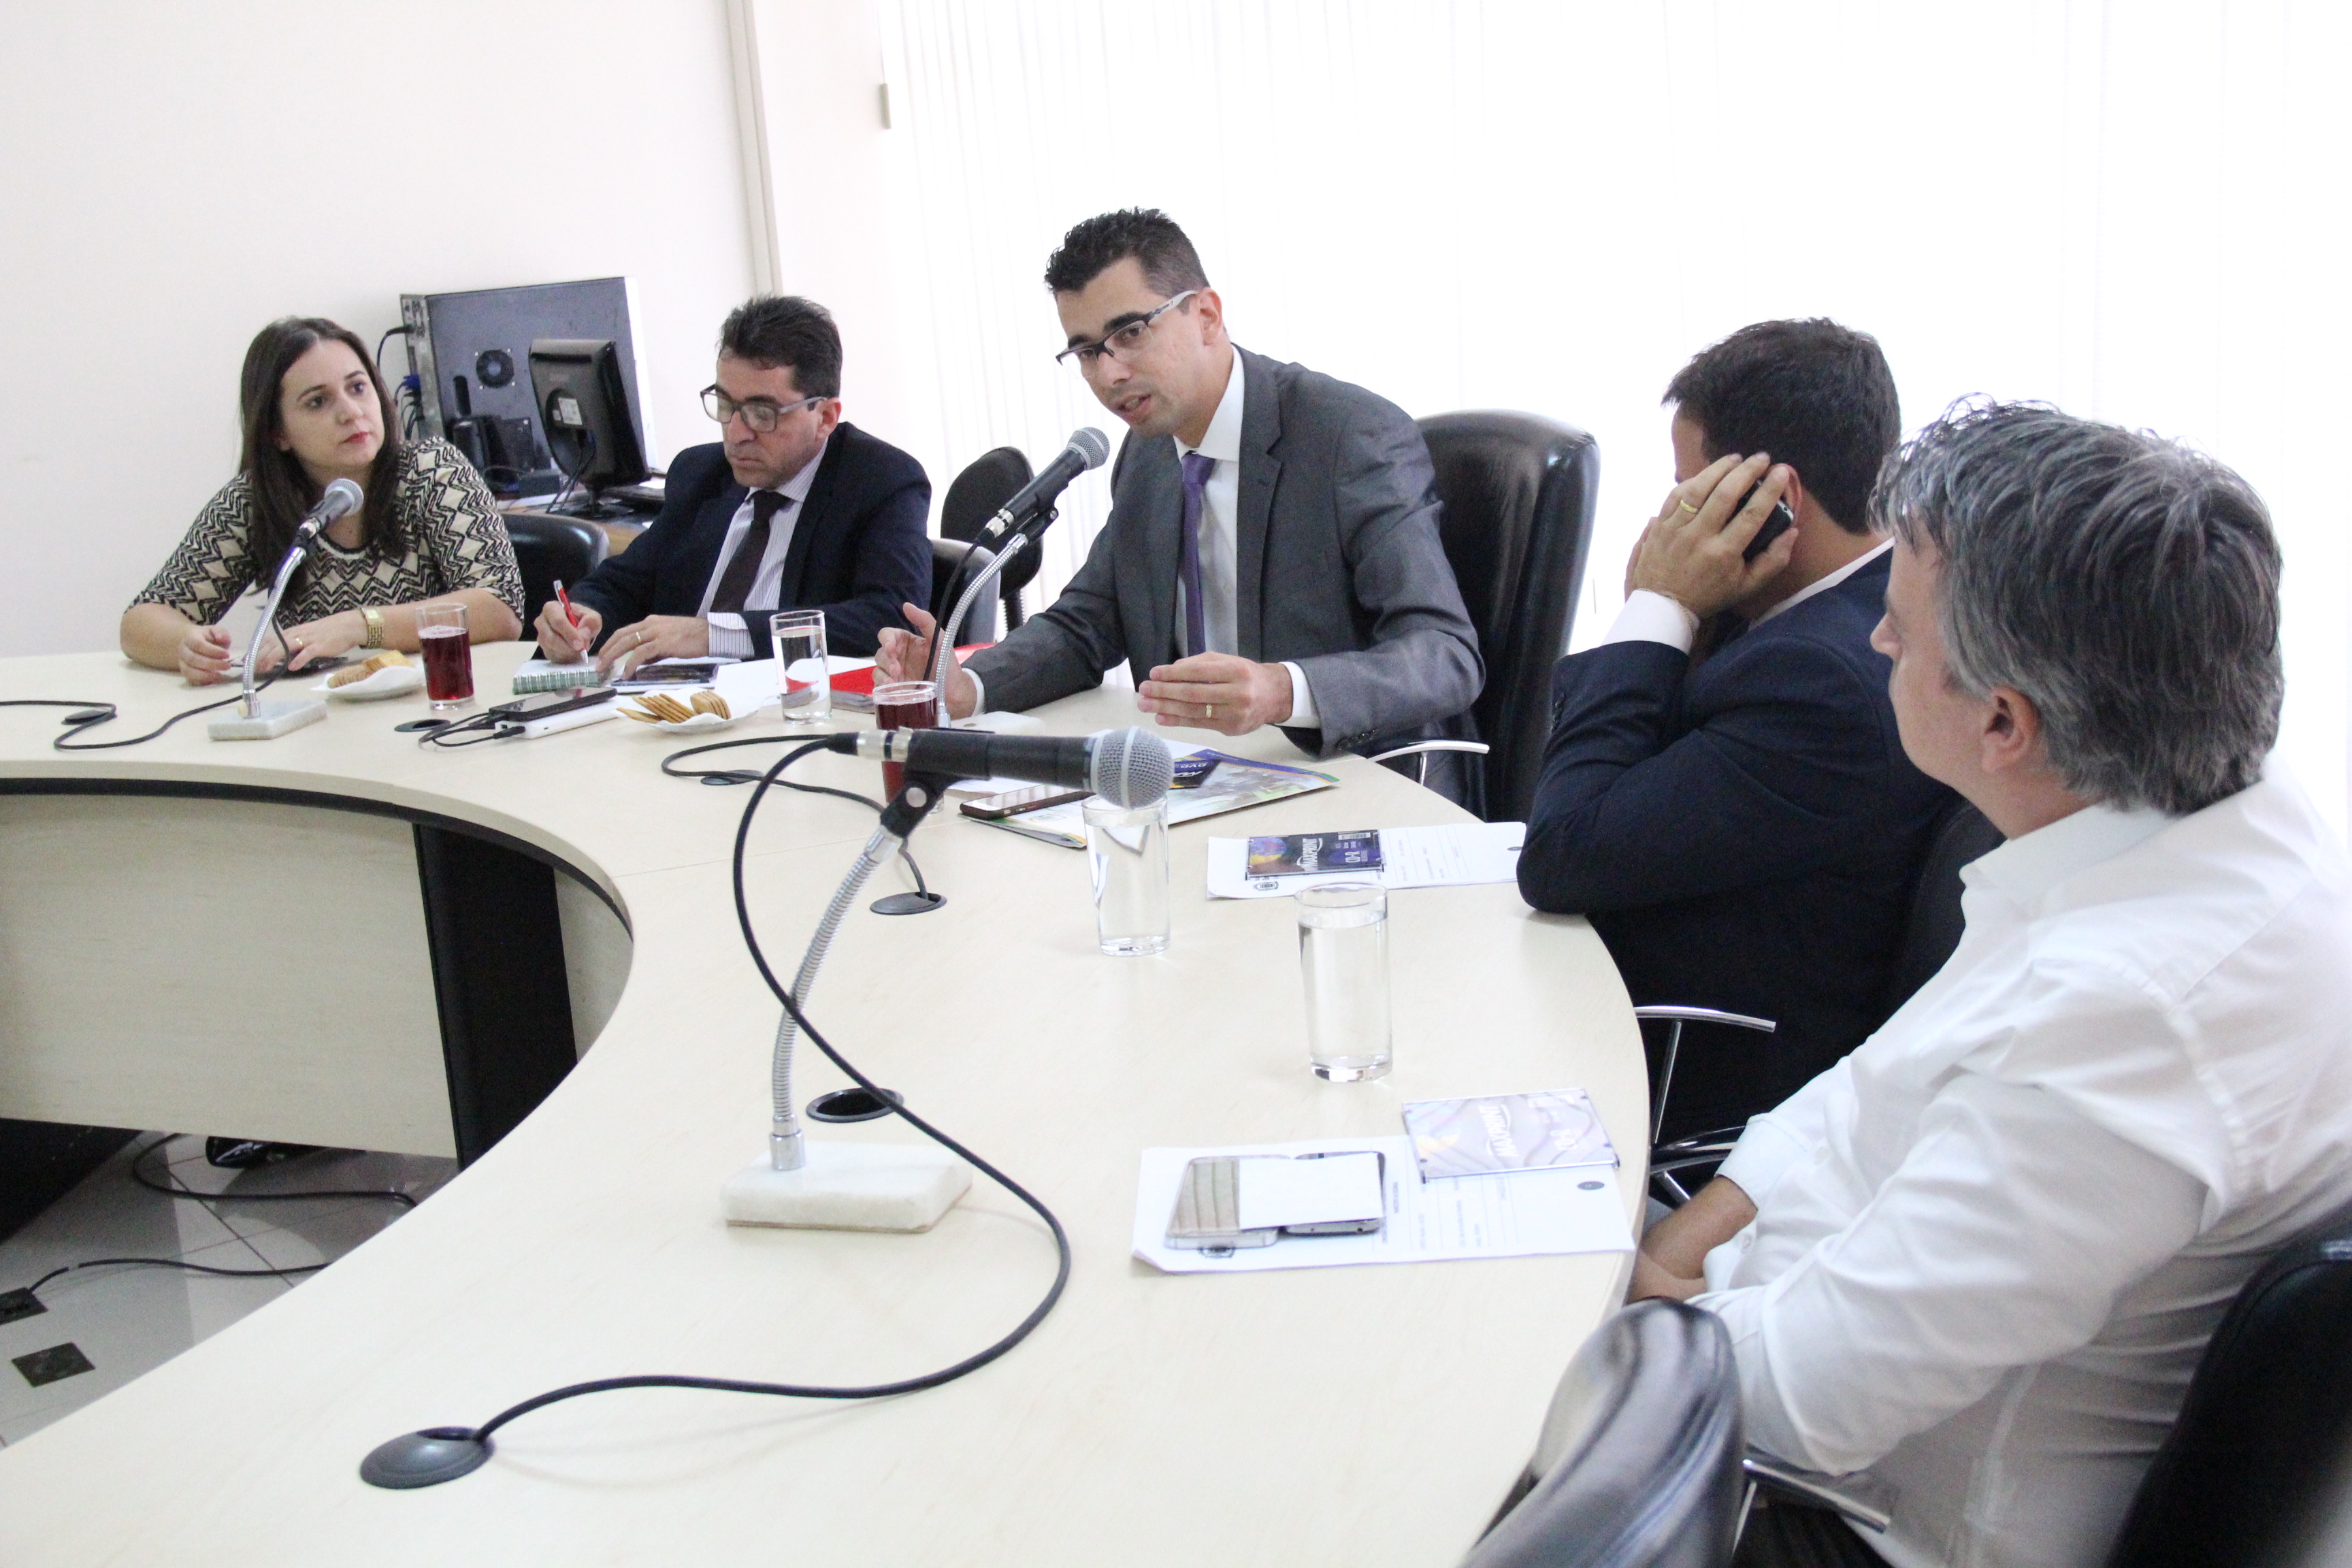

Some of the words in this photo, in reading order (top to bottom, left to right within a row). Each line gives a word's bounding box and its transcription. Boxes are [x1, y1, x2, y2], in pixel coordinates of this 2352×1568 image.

[1302, 838, 1318, 867] MAXPRINT
[1345, 851, 1360, 863] CD-R
[1478, 1105, 1519, 1157] MAXPRINT
